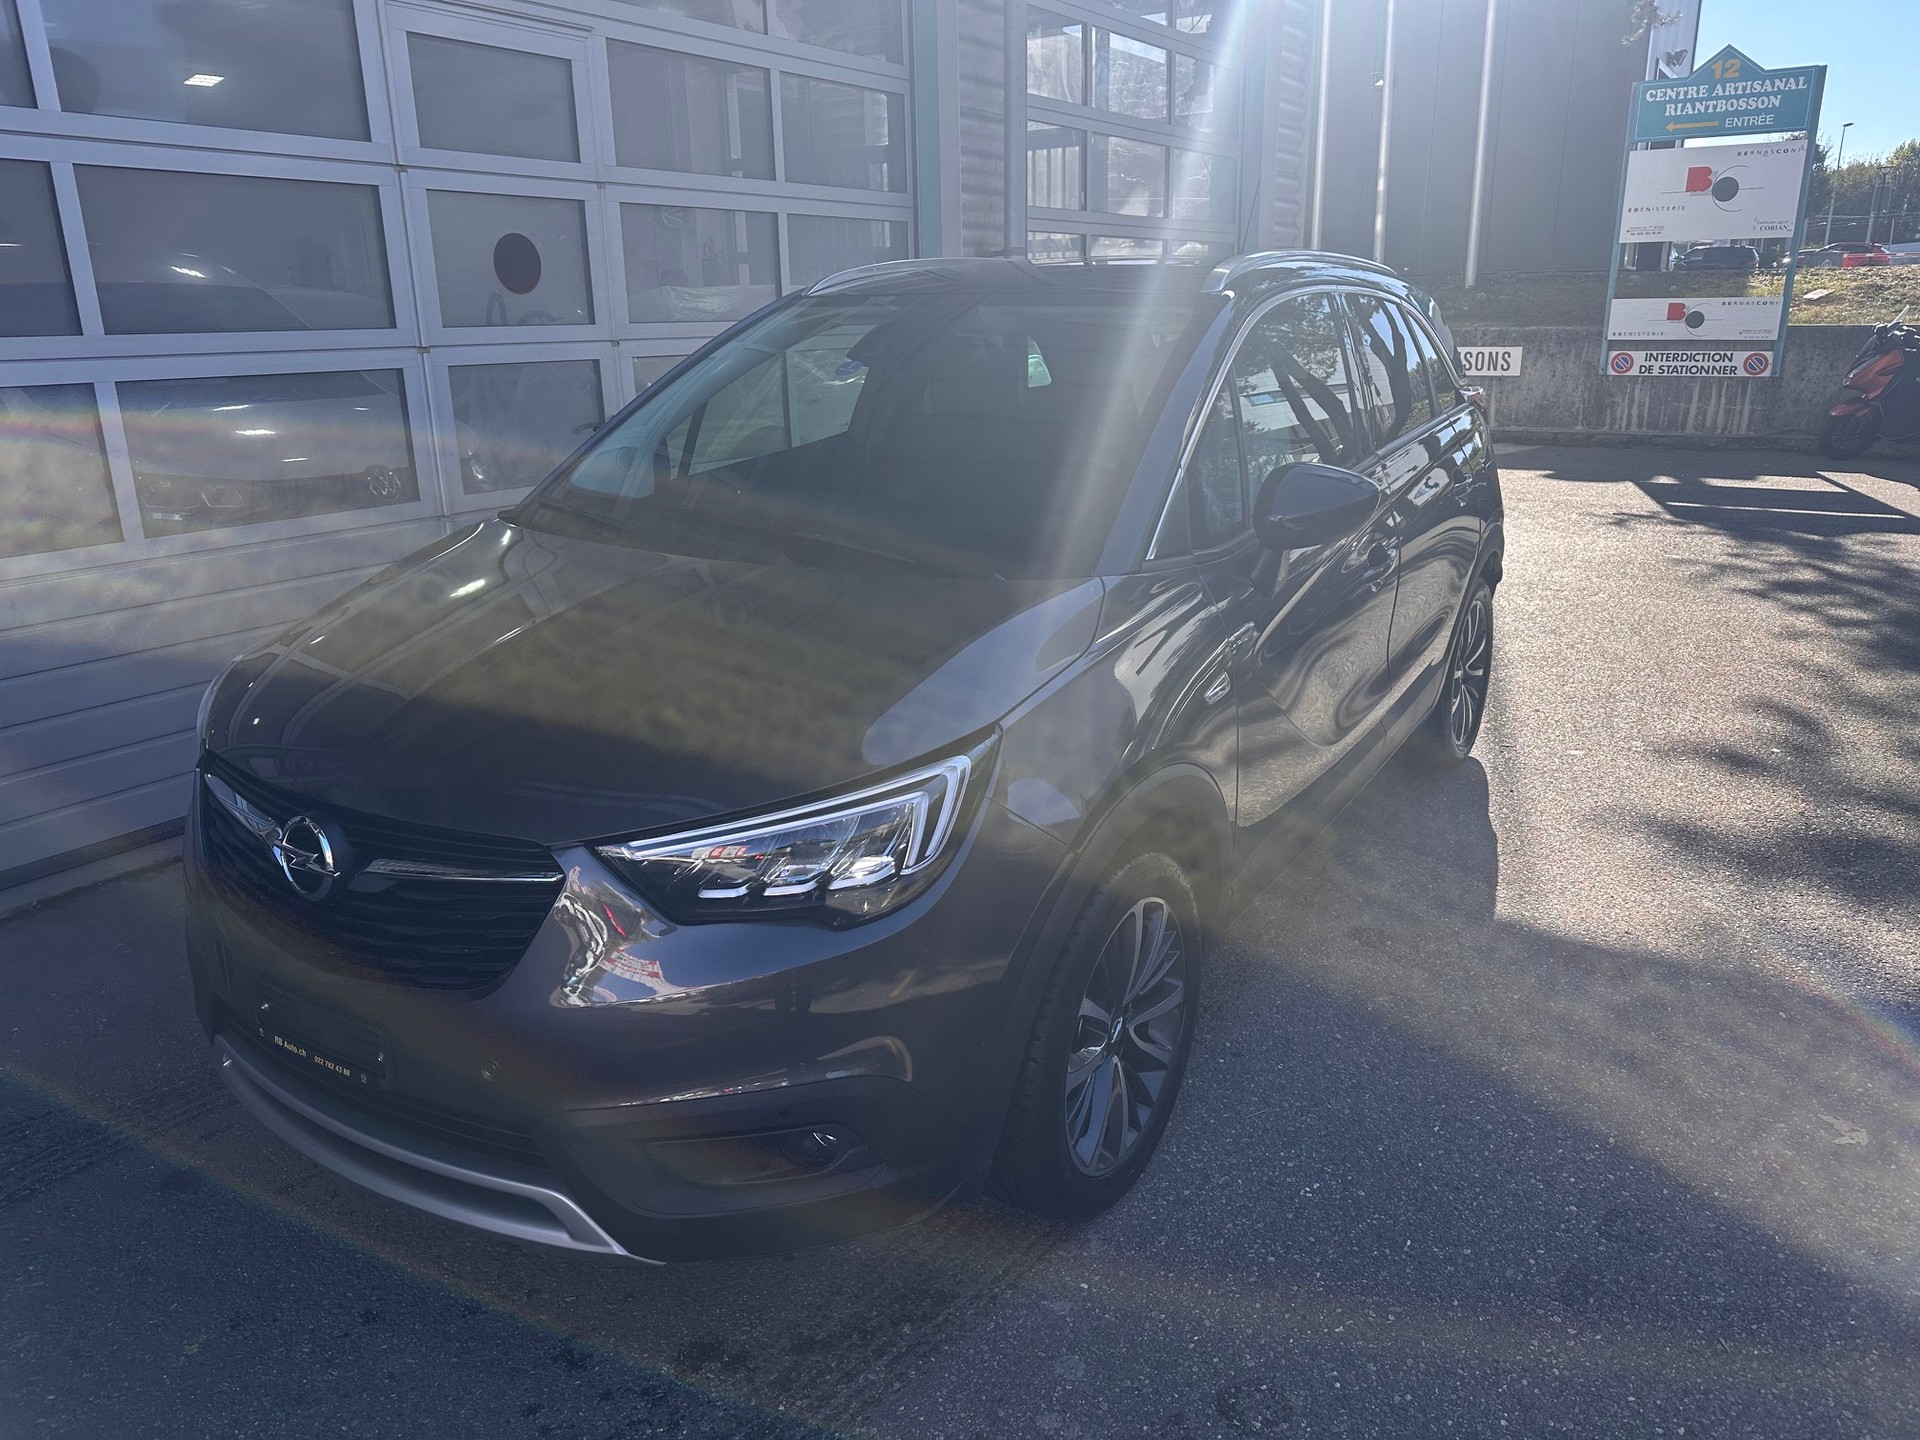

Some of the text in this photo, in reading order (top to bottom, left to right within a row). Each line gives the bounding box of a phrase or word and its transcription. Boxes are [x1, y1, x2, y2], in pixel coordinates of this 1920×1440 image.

[1711, 58, 1741, 79] 12
[1645, 76, 1808, 102] CENTRE ARTISANAL
[1664, 95, 1782, 116] RIANTBOSSON
[1724, 112, 1775, 128] ENTRÉE
[1736, 147, 1802, 157] BERNASCONI
[1627, 204, 1686, 213] EBENISTERIE
[1644, 352, 1734, 363] INTERDICTION
[1638, 364, 1738, 376] DE STATIONNER
[274, 1035, 307, 1058] RB Auto.ch
[335, 1065, 343, 1074] 43
